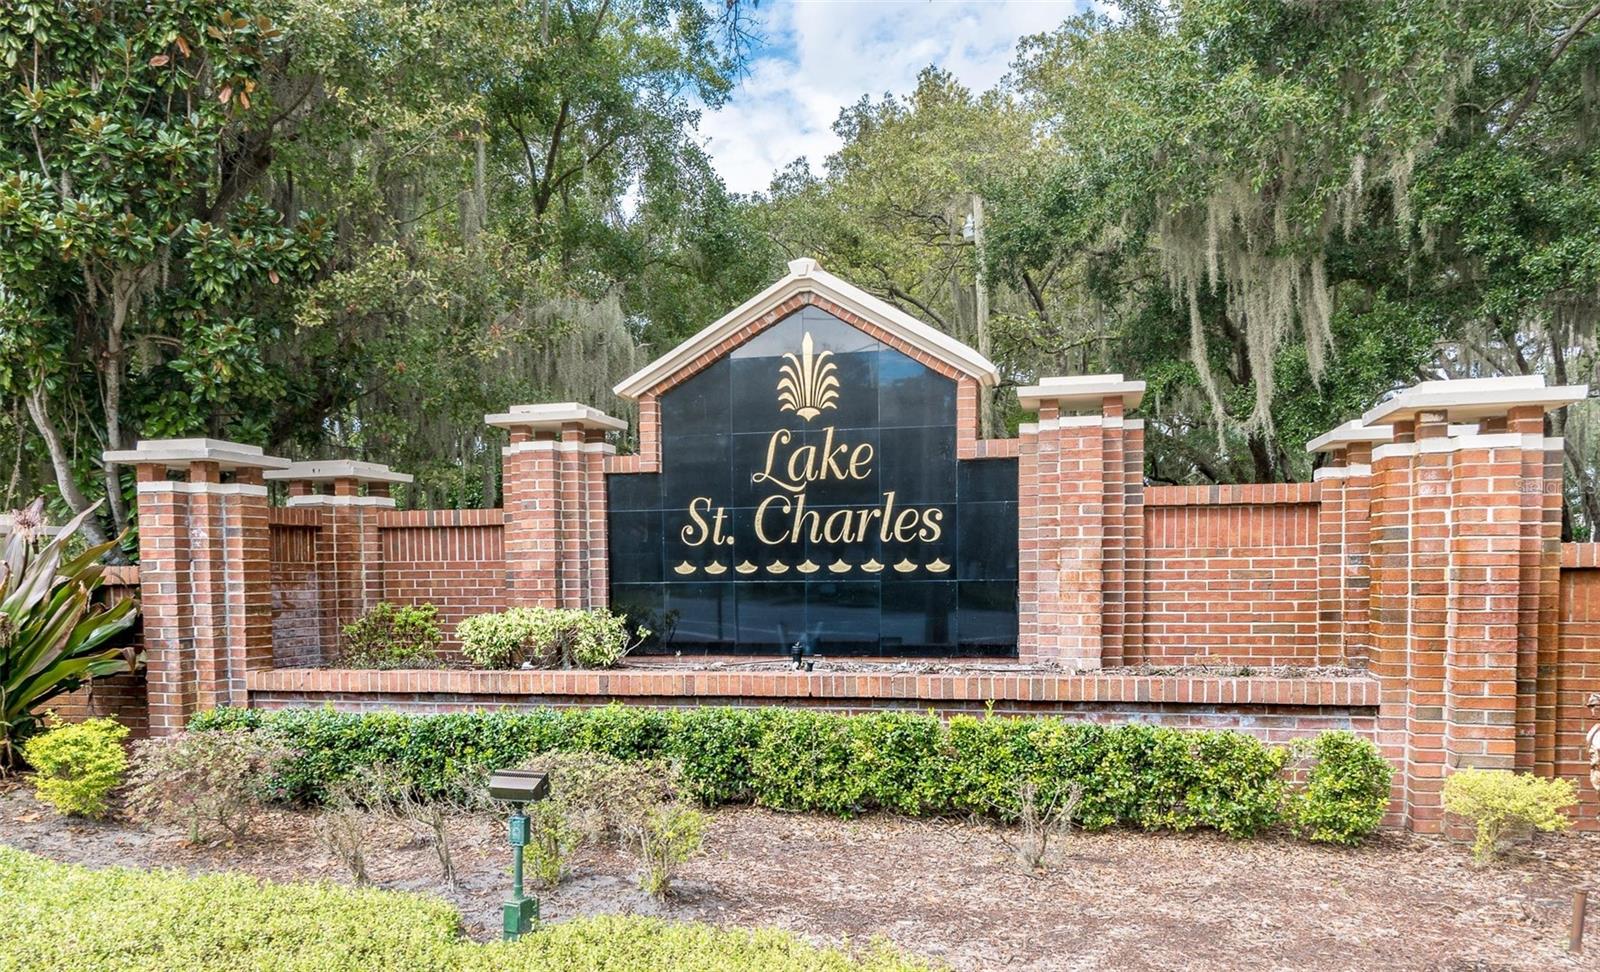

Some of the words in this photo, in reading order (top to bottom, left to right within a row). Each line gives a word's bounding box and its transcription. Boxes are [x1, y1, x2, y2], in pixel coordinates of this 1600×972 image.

[751, 426, 874, 492] Lake
[681, 497, 735, 546] St.
[754, 491, 943, 545] Charles
